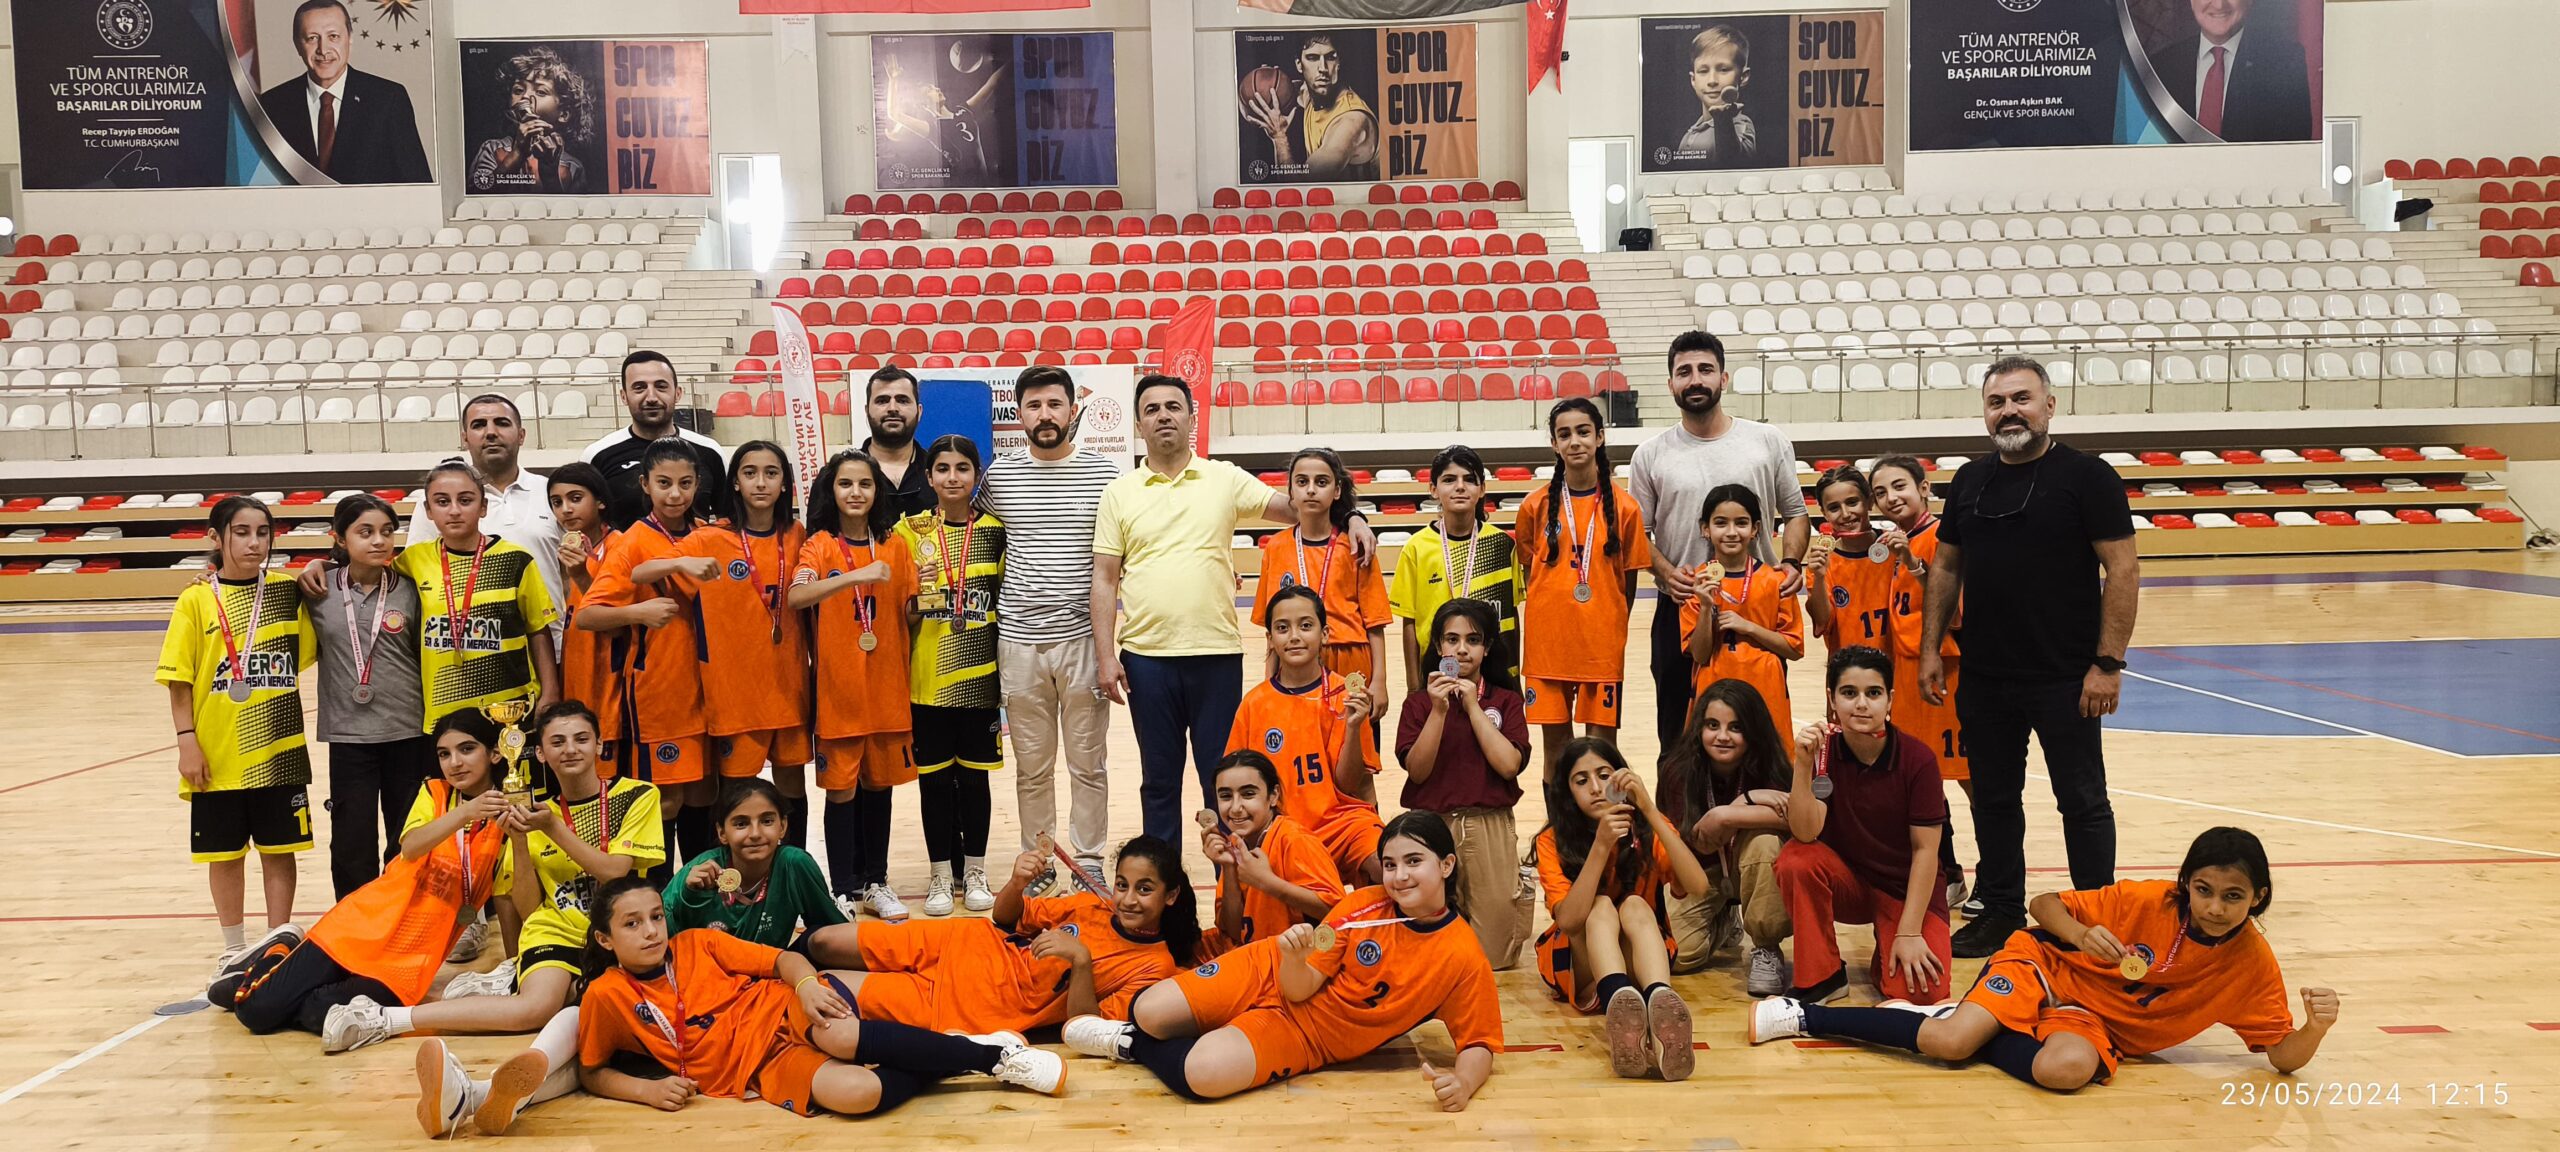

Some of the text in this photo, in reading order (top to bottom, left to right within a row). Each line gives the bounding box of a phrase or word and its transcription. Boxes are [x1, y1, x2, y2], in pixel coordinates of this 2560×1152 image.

[1386, 30, 1448, 74] SPOR
[1798, 20, 1856, 60] SPOR
[1959, 30, 2080, 48] TÜM ANTRENÖR
[614, 45, 676, 87] SPOR
[1023, 37, 1084, 79] SPOR
[1941, 47, 2097, 64] VE SPORCULARIMIZA
[66, 64, 189, 80] TÜM ANTRENÖR
[1947, 64, 2092, 82] BAŞARILAR DİLİYORUM
[49, 82, 207, 96] VE SPORCULARIMIZA
[1976, 96, 2063, 107] Dr. Osman Aşkın BAK
[57, 98, 202, 113] BAŞARILAR DİLİYORUM
[1963, 108, 2075, 120] GENÇLİK VE SPOR BAKANI
[82, 126, 180, 136] Recep Tayyip ERDOĞAN
[84, 138, 180, 148] T.C. CUMHURBAŞKANI
[1798, 113, 1835, 160] BİZ
[618, 144, 657, 190] BİZ
[1026, 136, 1065, 183] BİZ
[1389, 130, 1427, 178] BİZ
[1860, 608, 1889, 638] 17
[1603, 685, 1614, 709] 3
[1293, 752, 1324, 786] 15
[1363, 981, 1390, 1009] 2
